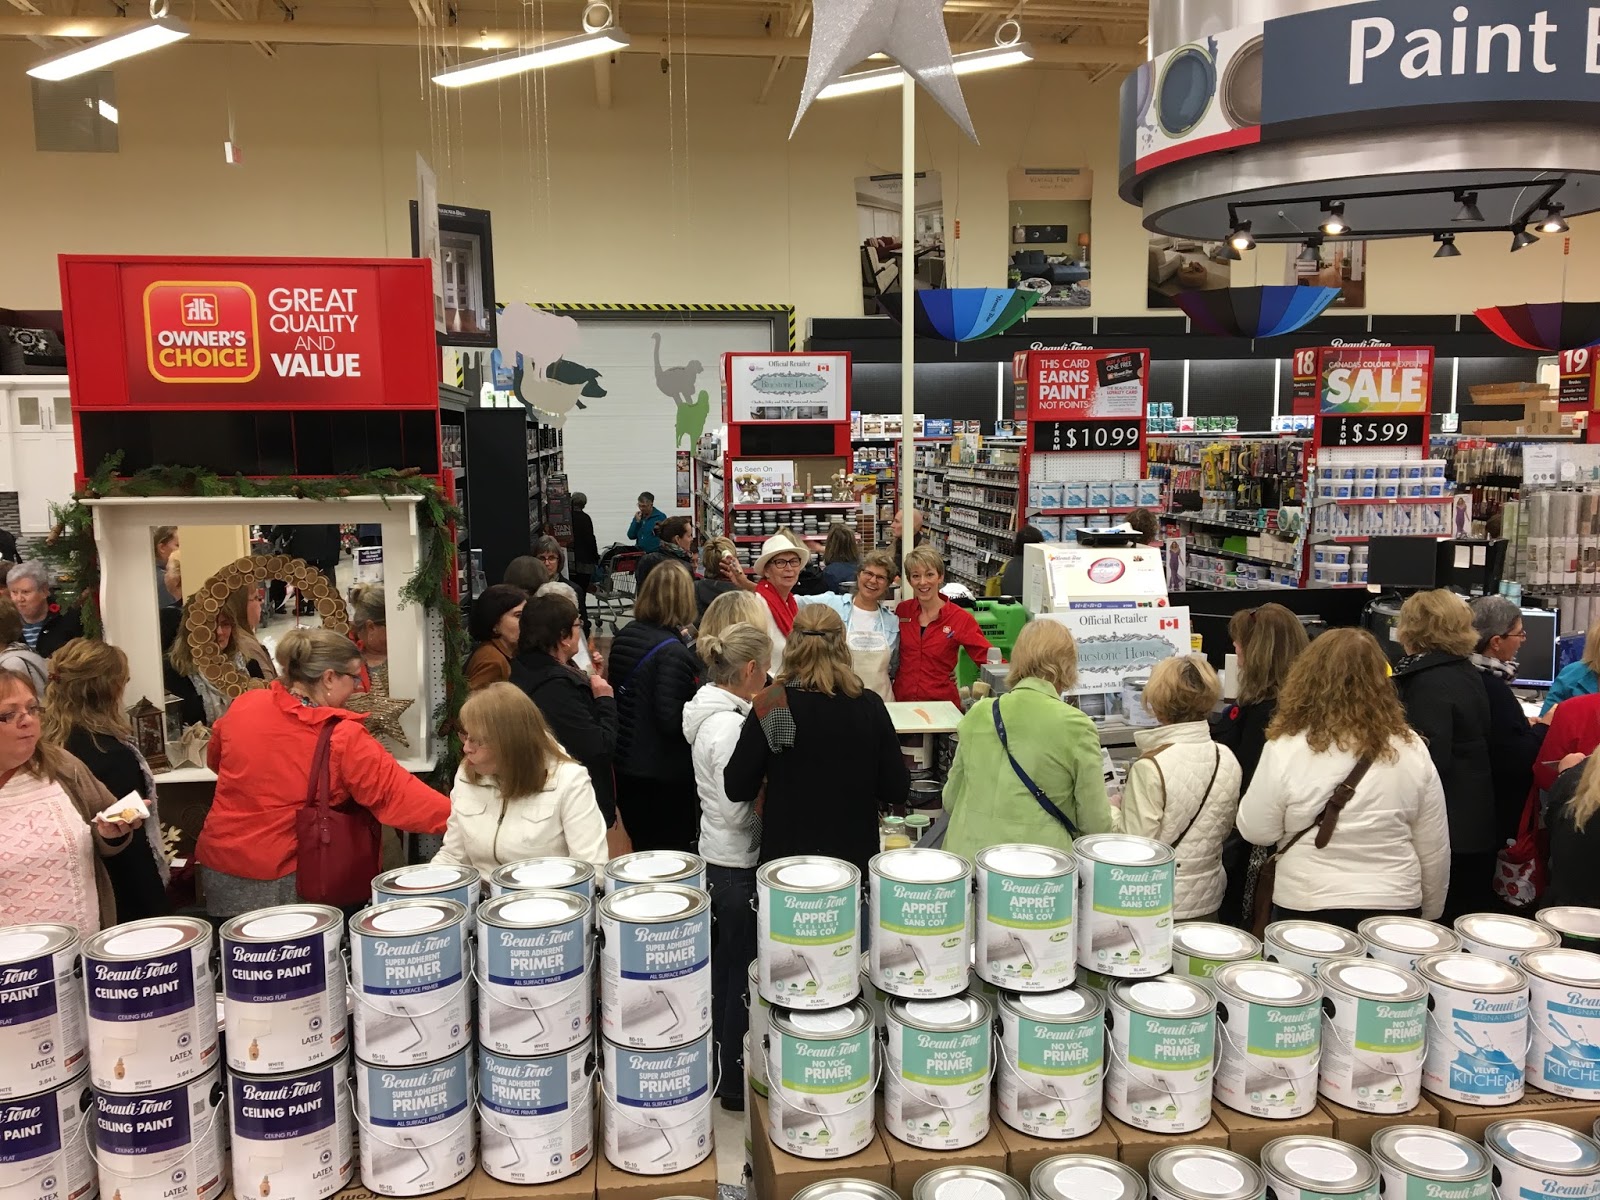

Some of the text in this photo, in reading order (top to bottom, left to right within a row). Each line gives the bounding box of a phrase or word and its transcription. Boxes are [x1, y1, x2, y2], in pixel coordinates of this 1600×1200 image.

[1348, 5, 1557, 85] Paint
[268, 288, 358, 313] GREAT
[270, 314, 358, 333] QUALITY
[158, 331, 246, 347] OWNER'S
[294, 335, 335, 351] AND
[159, 347, 248, 368] CHOICE
[270, 353, 361, 378] VALUE
[1040, 359, 1090, 369] THIS CARD
[1297, 350, 1315, 375] 18
[1564, 348, 1589, 373] 19
[1014, 353, 1027, 379] 17
[1039, 370, 1089, 383] EARNS
[1039, 384, 1089, 400] PAINT
[1326, 368, 1423, 404] SALE
[1039, 401, 1089, 409] NOT POINTS
[1066, 427, 1139, 448] $10.99
[1352, 423, 1408, 443] $5.99
[1079, 613, 1148, 626] Official Retailer
[1077, 646, 1159, 662] luestone House
[1110, 868, 1168, 882] Beauti-Tone
[893, 884, 956, 900] Beauti-Tone
[1001, 879, 1064, 895] Beauti-Tone
[1119, 881, 1161, 895] APPRÊT
[784, 895, 847, 910] Beauti-Tone
[901, 899, 948, 915] APPRÊT
[1009, 893, 1056, 908] APPRÊT
[1121, 900, 1160, 908] SANS COV
[792, 908, 839, 925] APPRÊT
[904, 918, 945, 926] SANS COV
[1012, 912, 1053, 920] SANS COV
[500, 929, 574, 947] Beauti-Tone
[634, 922, 703, 943] Beauti-Tone
[795, 927, 837, 937] SANS COV
[374, 936, 451, 957] Beauti-Tone
[510, 945, 563, 957] SUPER ADHERENT
[645, 937, 695, 952] SUPER ADHERENT
[232, 945, 310, 963] Beauti-Tone
[384, 952, 440, 966] SUPER ADHERENT
[645, 946, 696, 965] PRIMER
[385, 961, 441, 980] PRIMER
[510, 955, 564, 971] PRIMER
[95, 961, 178, 982] Beauti-Tone
[232, 963, 312, 981] CEILING PAINT
[658, 971, 677, 979] SURFACE
[678, 967, 693, 976] PRIMER
[1, 986, 40, 1003] PAINT
[95, 979, 179, 1000] CEILING PAINT
[400, 986, 421, 994] SURFACE
[421, 983, 439, 991] PRIMER
[1146, 1019, 1208, 1035] Beauti-Tone
[1283, 1023, 1312, 1033] NO VOC
[1406, 1018, 1421, 1027] VOC
[301, 1033, 323, 1045] LATEX
[1034, 1024, 1096, 1040] Beauti-Tone
[1276, 1029, 1315, 1044] PRIMER
[1384, 1025, 1423, 1040] PRIMER
[795, 1041, 861, 1057] Beauti-Tone
[917, 1033, 981, 1050] Beauti-Tone
[1051, 1041, 1083, 1050] NO VOC
[1162, 1037, 1194, 1046] NO VOC
[170, 1049, 193, 1063] LATEX
[948, 1051, 967, 1059] VOC
[1043, 1047, 1089, 1062] PRIMER
[1154, 1043, 1200, 1057] PRIMER
[31, 1057, 56, 1070] LATEX
[485, 1056, 553, 1078] Beauti-Tone
[629, 1050, 699, 1070] Beauti-Tone
[812, 1058, 845, 1068] NO VOC
[926, 1056, 973, 1071] PRIMER
[1567, 1059, 1595, 1068] VELVET
[381, 1066, 456, 1088] Beauti-Tone
[639, 1066, 690, 1080] SUPER ADHERENT
[805, 1064, 852, 1079] PRIMER
[1453, 1071, 1515, 1087] KITCHEN
[1473, 1067, 1500, 1075] VELVET
[1547, 1063, 1600, 1082] KITCHE
[491, 1075, 540, 1087] SUPER ADHERENT
[639, 1075, 691, 1093] PRIMER
[242, 1080, 321, 1100] Beauti-Tone
[392, 1083, 446, 1098] SUPER ADHERENT
[492, 1084, 541, 1100] PRIMER
[97, 1096, 172, 1115] Beauti-Tone
[242, 1098, 322, 1118] CEILING PAINT
[392, 1092, 448, 1112] PRIMER
[4, 1124, 43, 1141] PAINT
[97, 1117, 174, 1133] CEILING PAINT
[312, 1166, 333, 1180] LATEX
[164, 1185, 188, 1198] LATEX
